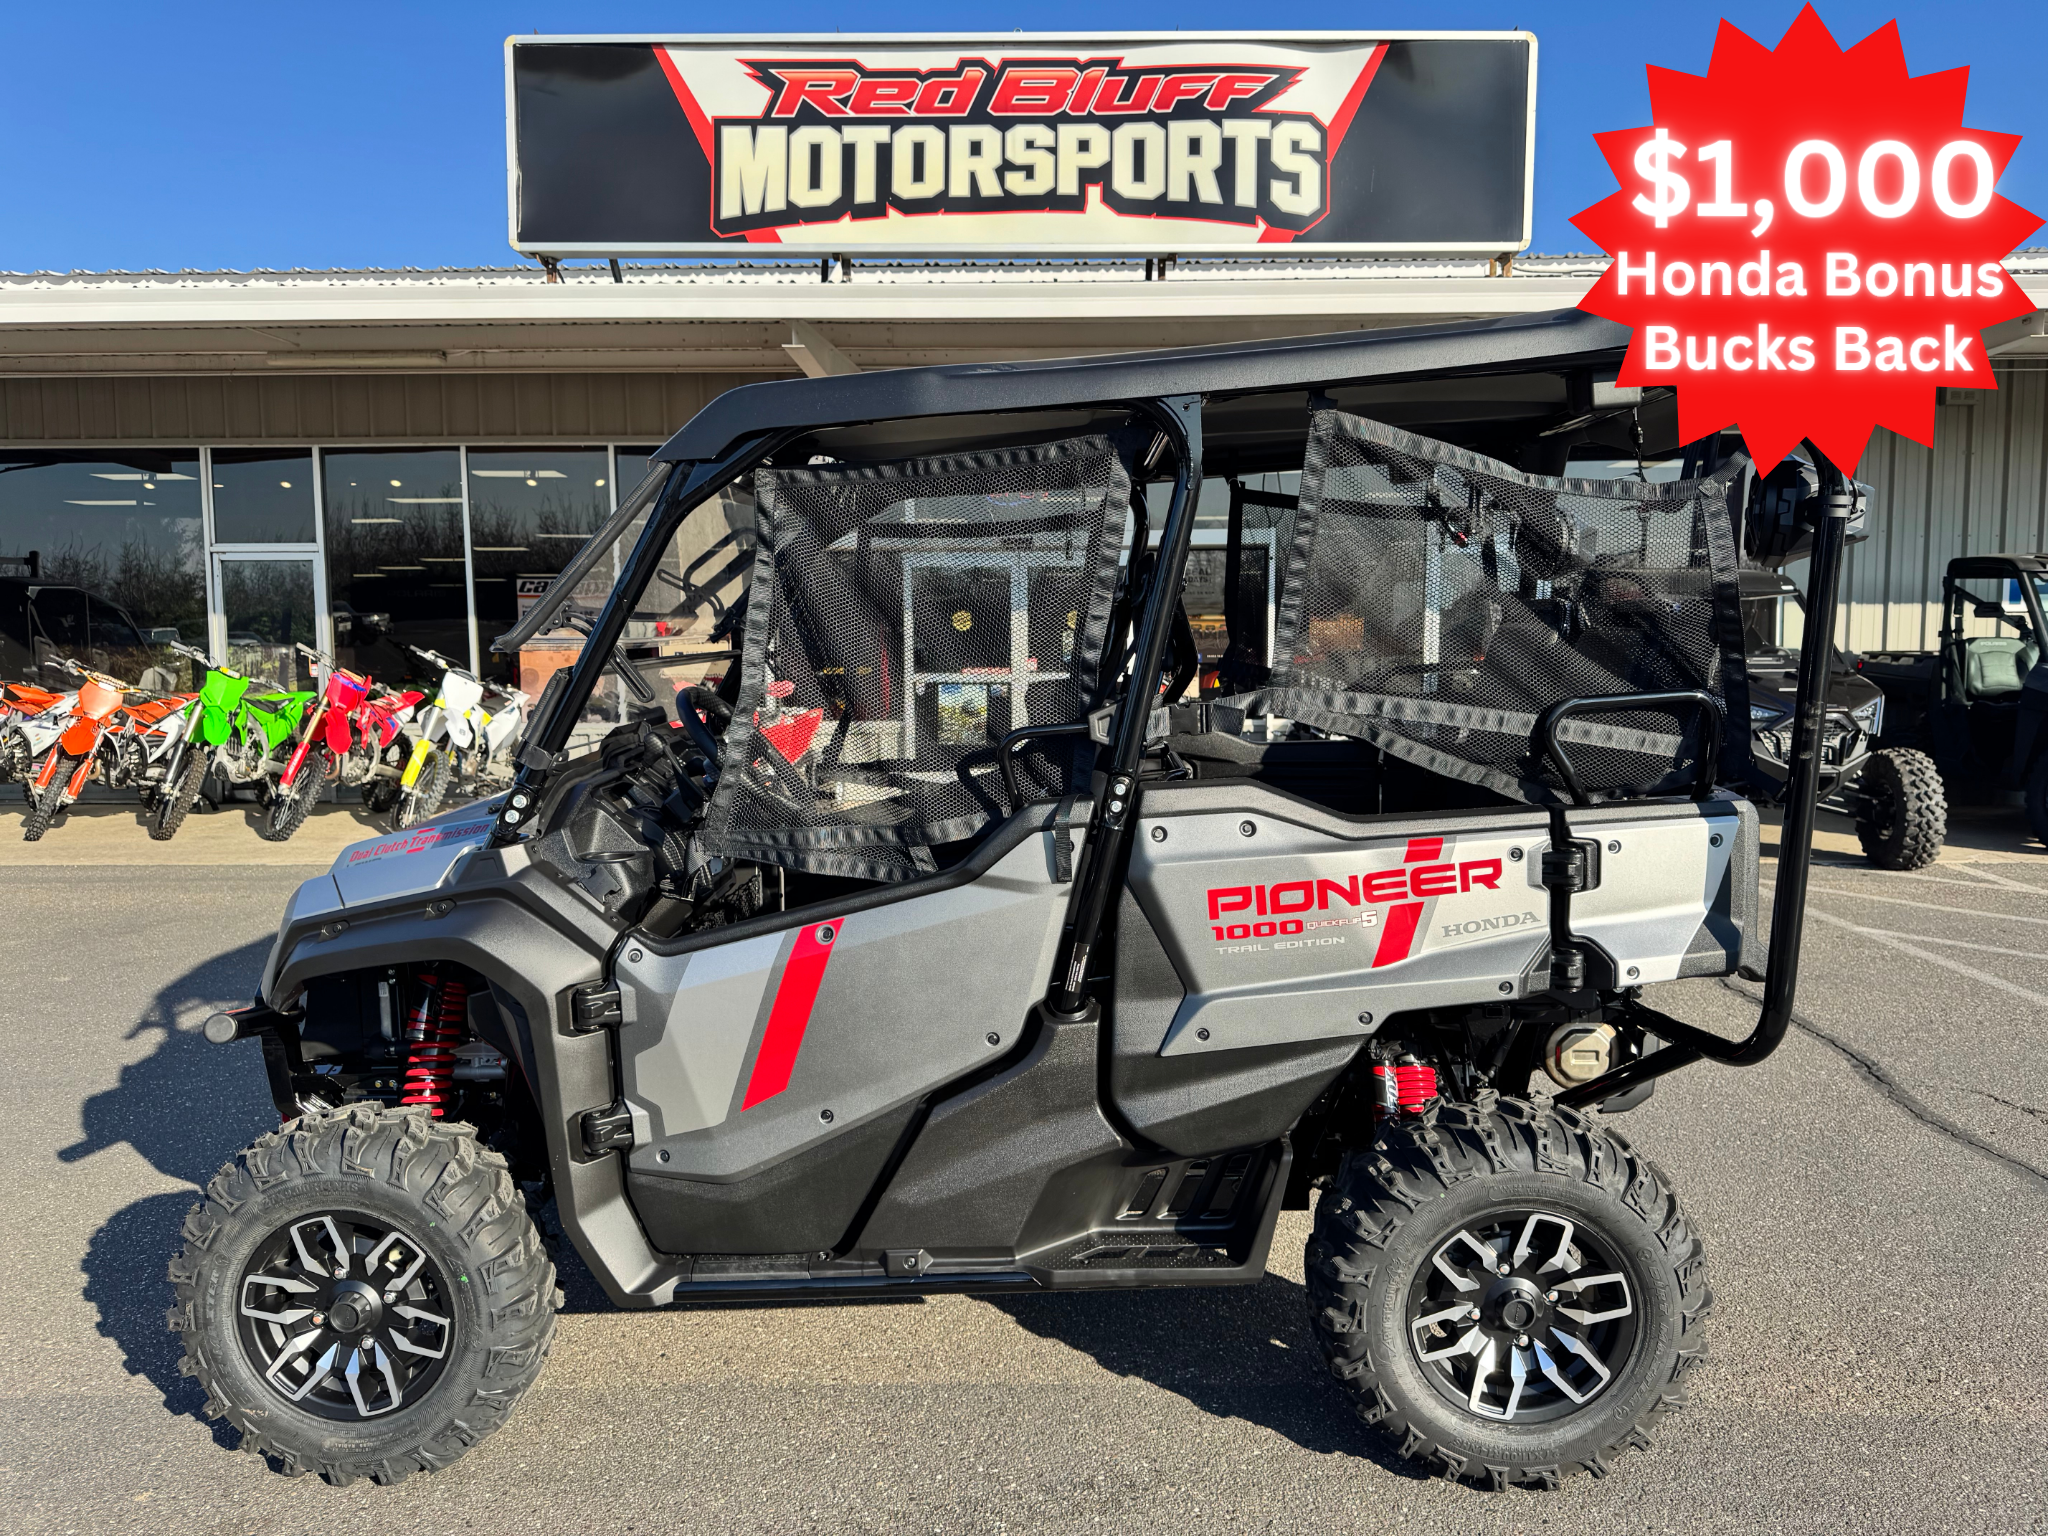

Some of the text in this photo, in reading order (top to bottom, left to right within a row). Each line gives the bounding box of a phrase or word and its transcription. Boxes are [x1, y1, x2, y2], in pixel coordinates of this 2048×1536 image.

[771, 66, 1278, 117] Red Bluff
[720, 119, 1322, 220] MOTORSPORTS
[349, 847, 375, 862] Dual
[373, 838, 409, 857] Clutch
[408, 823, 490, 848] Transmission
[1207, 857, 1503, 921] PIONEER
[1210, 919, 1304, 941] 1000
[1441, 911, 1541, 938] HONDA
[1215, 936, 1346, 955] TRAIL EDITION
